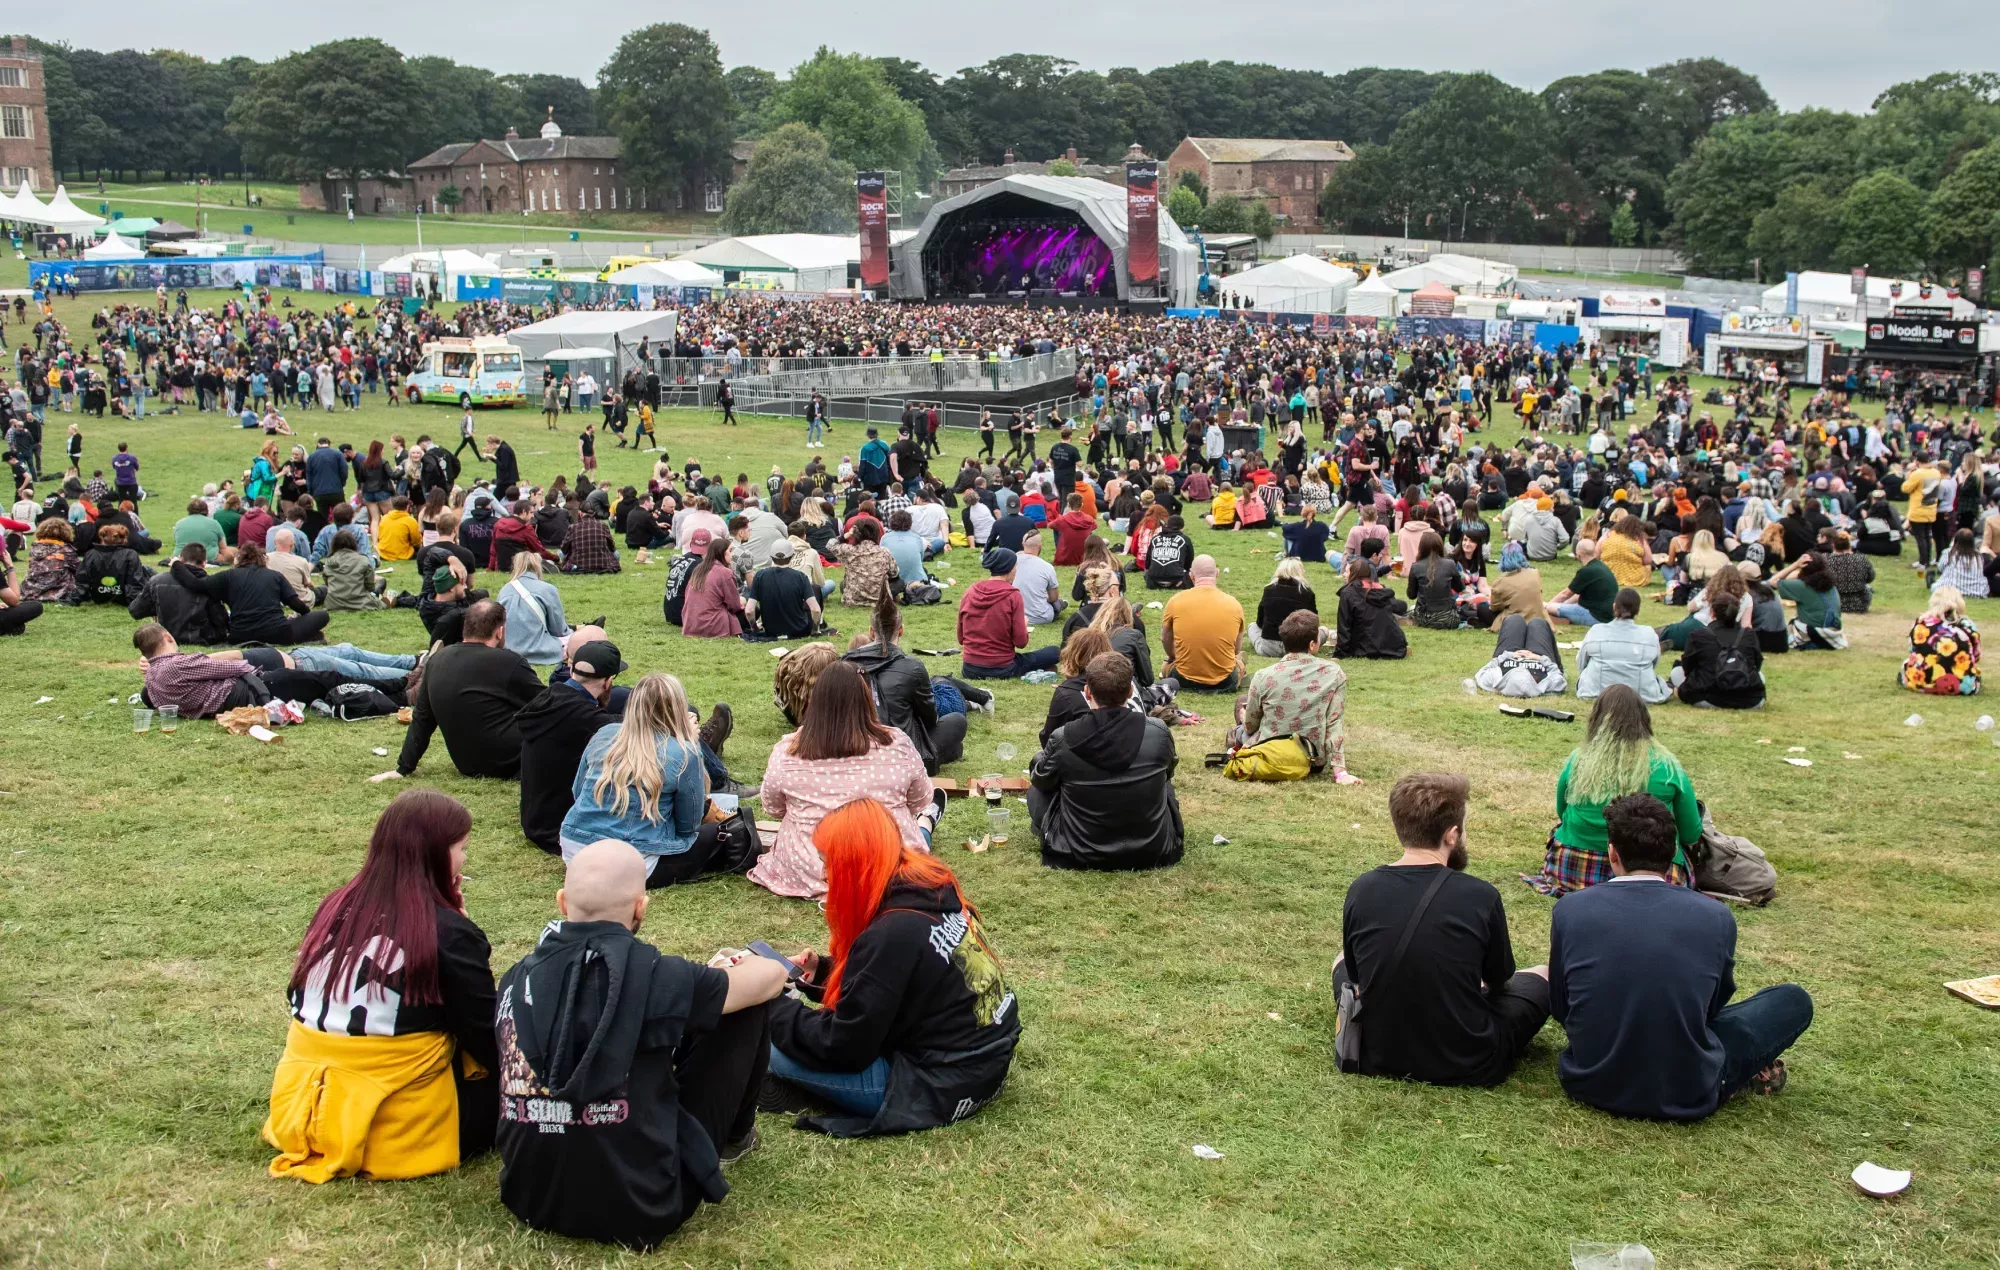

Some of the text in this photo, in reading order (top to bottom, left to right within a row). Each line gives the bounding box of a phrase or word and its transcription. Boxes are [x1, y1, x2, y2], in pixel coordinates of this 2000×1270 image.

[1130, 195, 1155, 203] ROCK
[1887, 323, 1955, 339] Noodle Bar
[526, 1098, 574, 1123] SLAM
[588, 1103, 619, 1113] Hatfield
